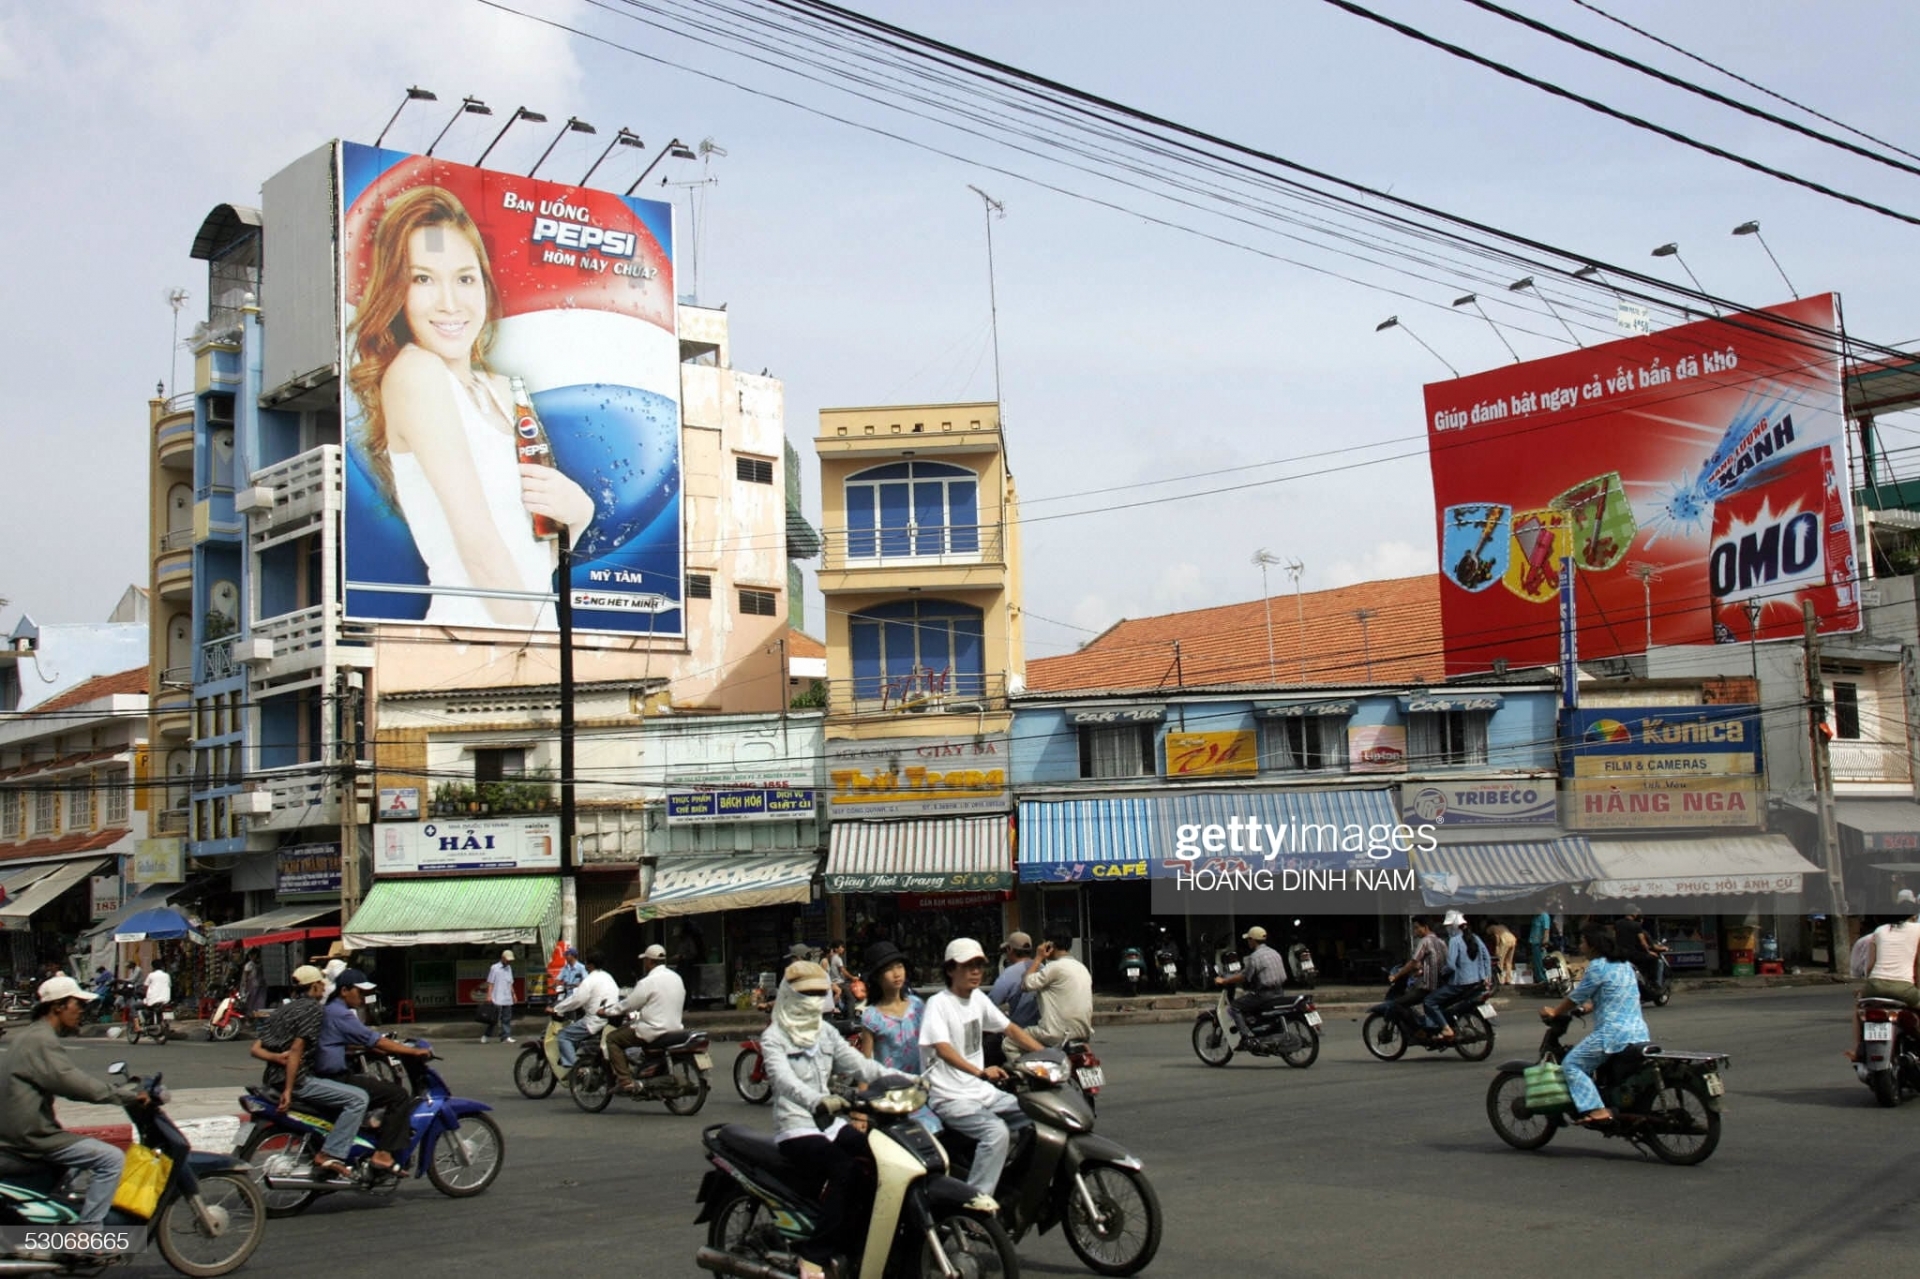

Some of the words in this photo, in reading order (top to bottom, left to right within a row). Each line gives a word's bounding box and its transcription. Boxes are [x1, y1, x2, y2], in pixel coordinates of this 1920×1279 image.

[540, 195, 590, 222] UỐNG
[532, 217, 637, 259] PEPSI
[543, 249, 576, 267] HÔM
[580, 256, 608, 273] NAY
[1434, 405, 1468, 431] Giúp
[1470, 398, 1508, 424] đánh
[1512, 391, 1538, 417] bật
[1540, 386, 1578, 411] ngay
[1582, 374, 1603, 399] cả
[1606, 366, 1635, 395] vết
[1638, 357, 1671, 388] bẩn
[1675, 354, 1699, 380] đã
[1703, 346, 1738, 374] khô
[1718, 413, 1795, 488] XANH
[1710, 511, 1818, 597] OMO
[614, 570, 642, 584] TÂM
[1642, 716, 1744, 744] Konica
[1605, 760, 1631, 771] FILM
[1637, 760, 1645, 771] &
[1648, 759, 1708, 770] CAMERAS
[720, 793, 742, 808] BÁCH
[1455, 789, 1538, 805] TRIBECO
[1683, 792, 1746, 812] NGA
[439, 829, 495, 851] HẢI
[1092, 860, 1148, 876] CAFÉ
[900, 875, 945, 888] Trang
